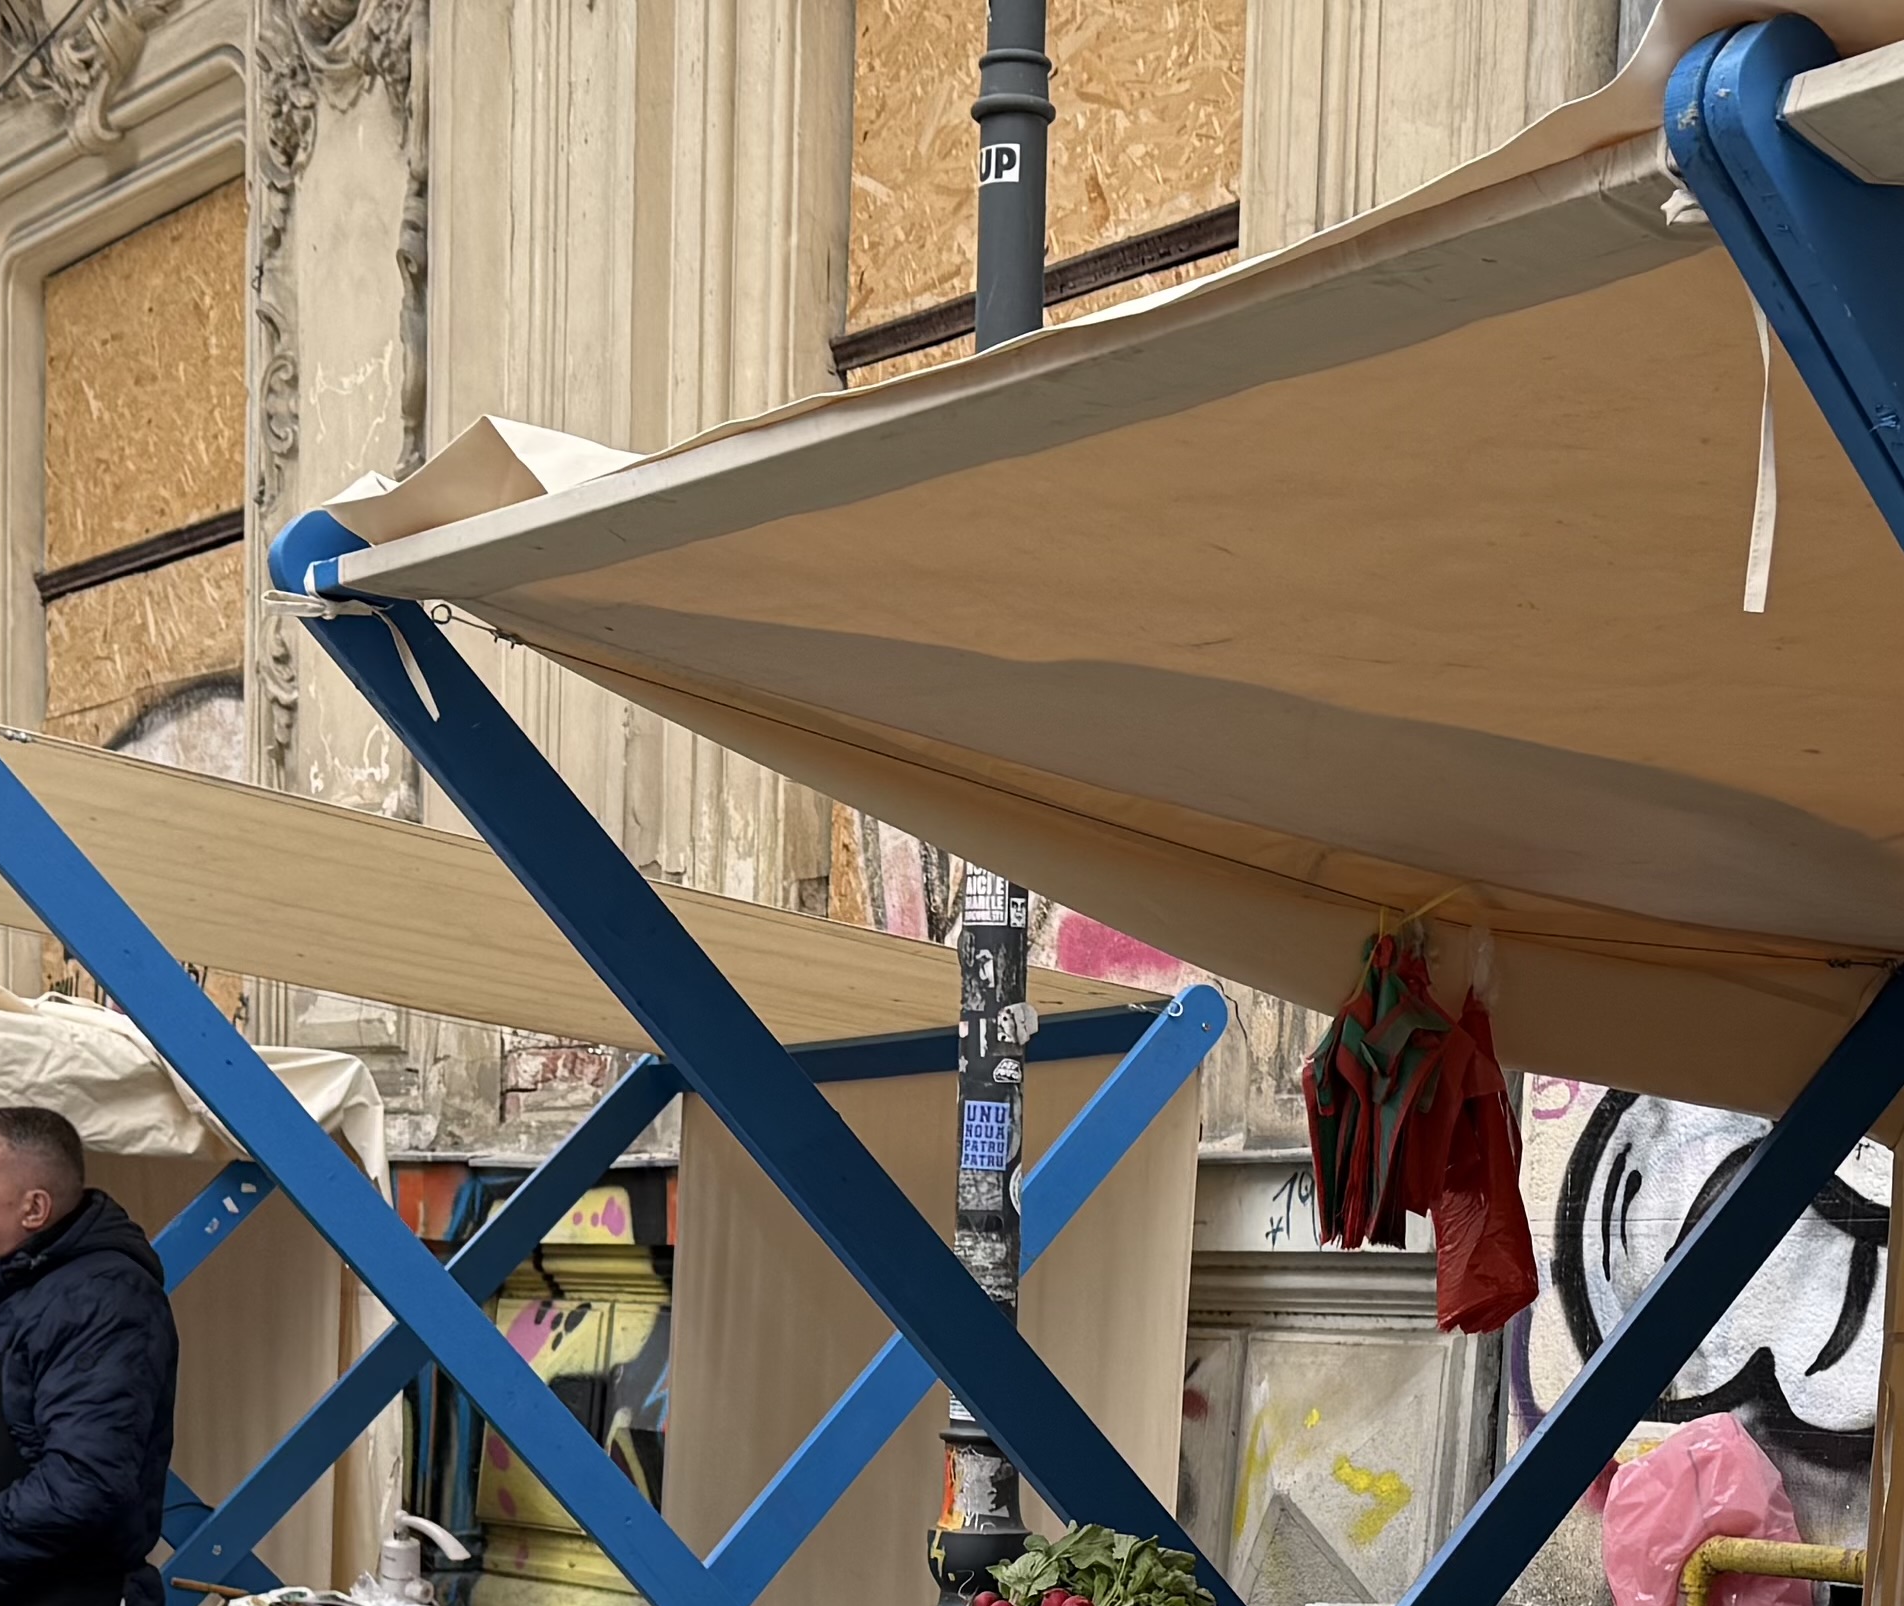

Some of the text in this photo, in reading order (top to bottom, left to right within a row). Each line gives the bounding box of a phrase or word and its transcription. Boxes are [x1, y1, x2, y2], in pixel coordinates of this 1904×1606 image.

[967, 1104, 1007, 1123] UNU
[964, 1140, 1005, 1154] PATRU
[963, 1154, 1004, 1168] PATRU
